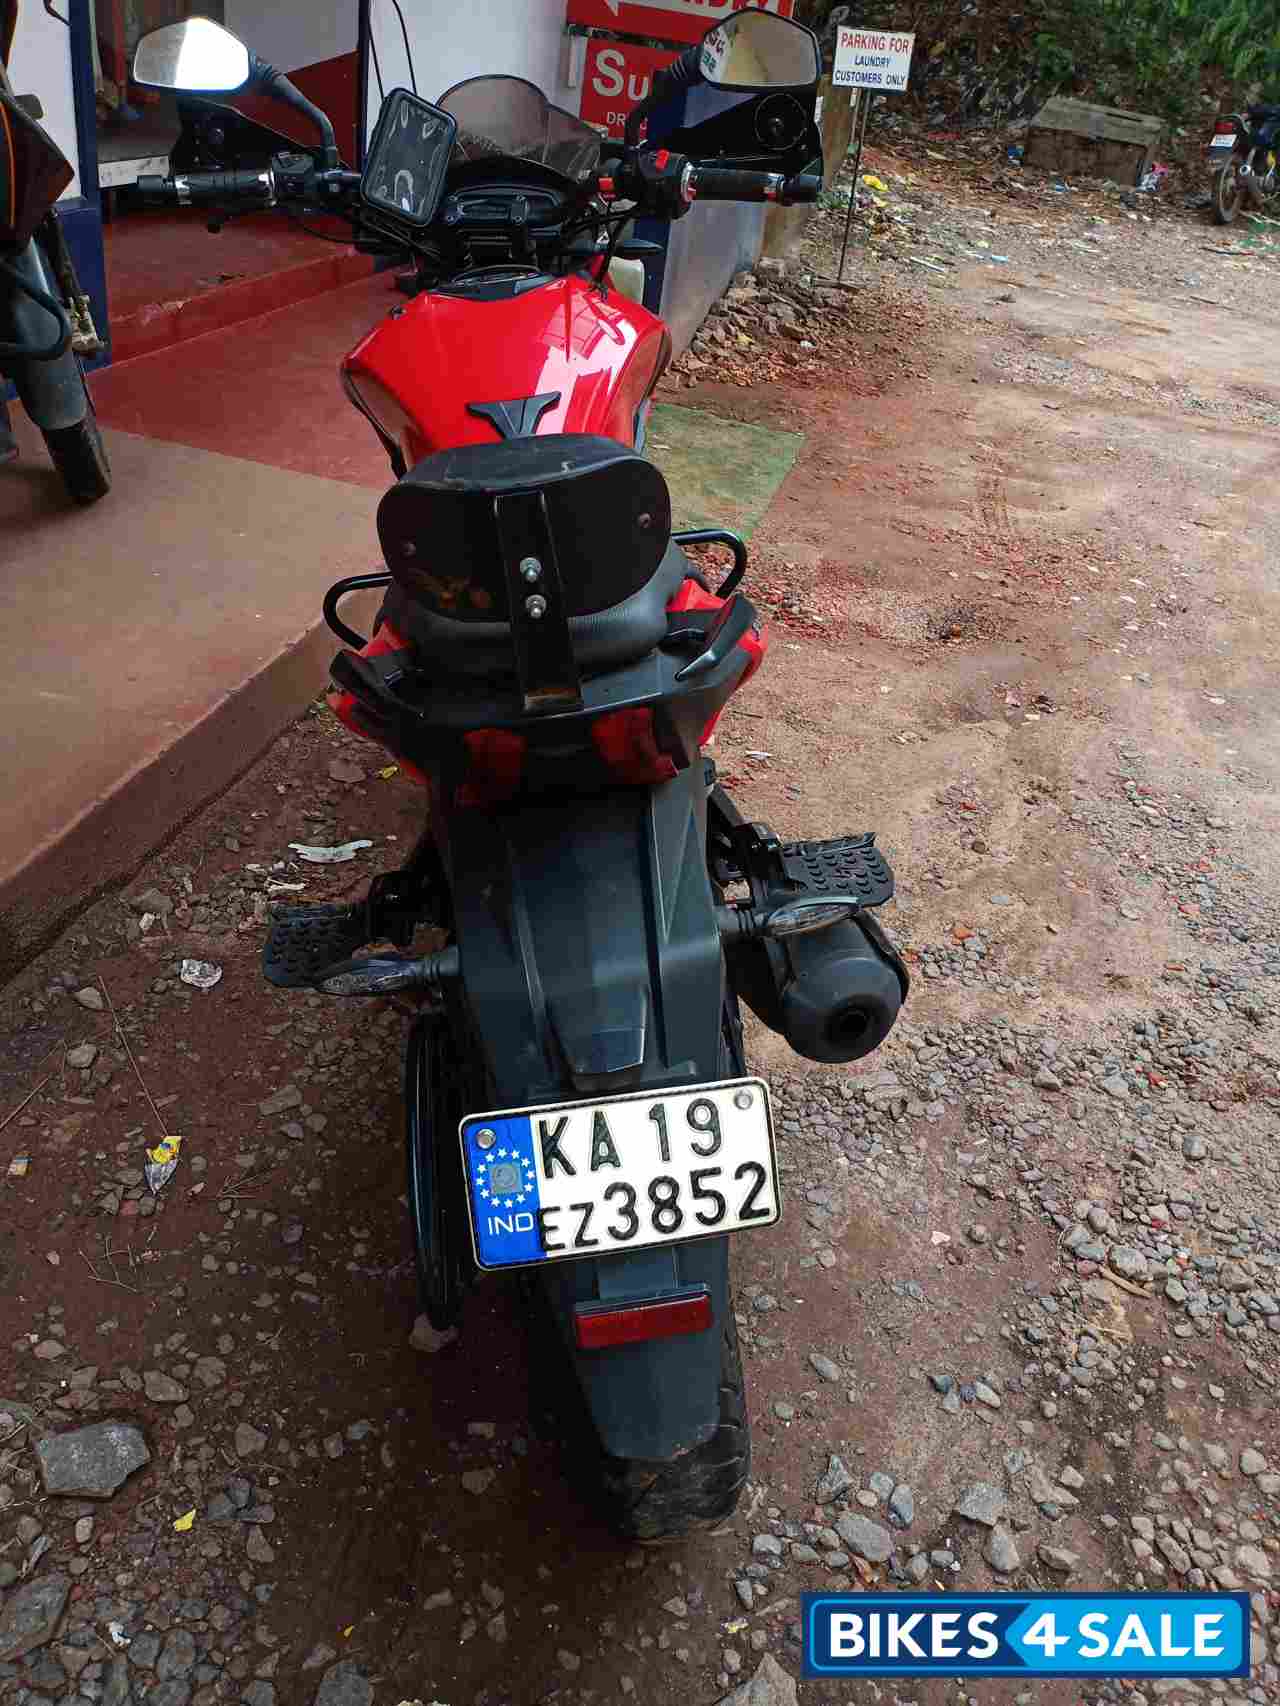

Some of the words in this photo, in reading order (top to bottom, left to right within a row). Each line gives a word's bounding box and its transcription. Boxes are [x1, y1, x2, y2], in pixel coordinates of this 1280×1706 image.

[840, 32, 886, 51] PARKING
[889, 37, 909, 55] FOR
[855, 53, 891, 68] LAUNDRY
[834, 69, 882, 84] CUSTOMERS
[886, 72, 907, 86] ONLY
[487, 1212, 534, 1236] IND
